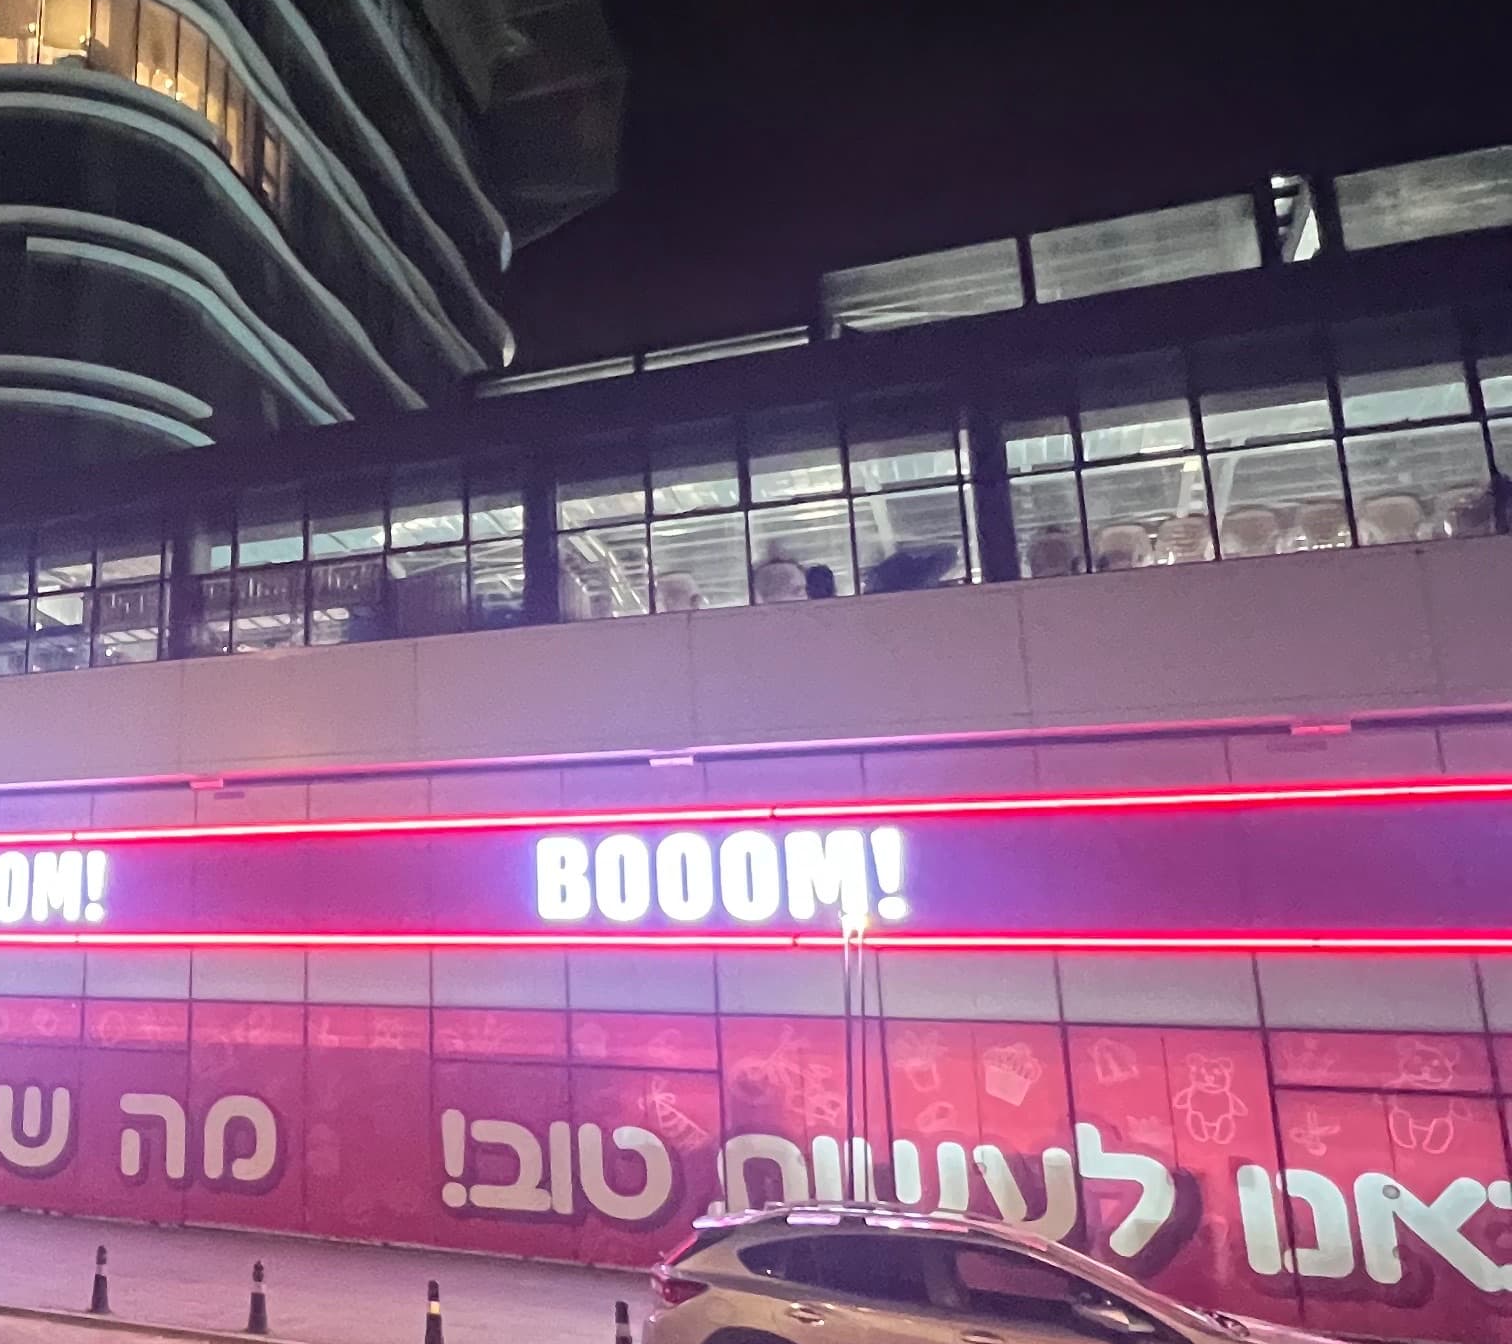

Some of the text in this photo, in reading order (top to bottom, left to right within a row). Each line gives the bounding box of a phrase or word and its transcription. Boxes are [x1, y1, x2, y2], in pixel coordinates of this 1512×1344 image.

[535, 827, 910, 923] BOOOM!
[119, 1093, 277, 1181] מה
[442, 1109, 673, 1221] טוב!
